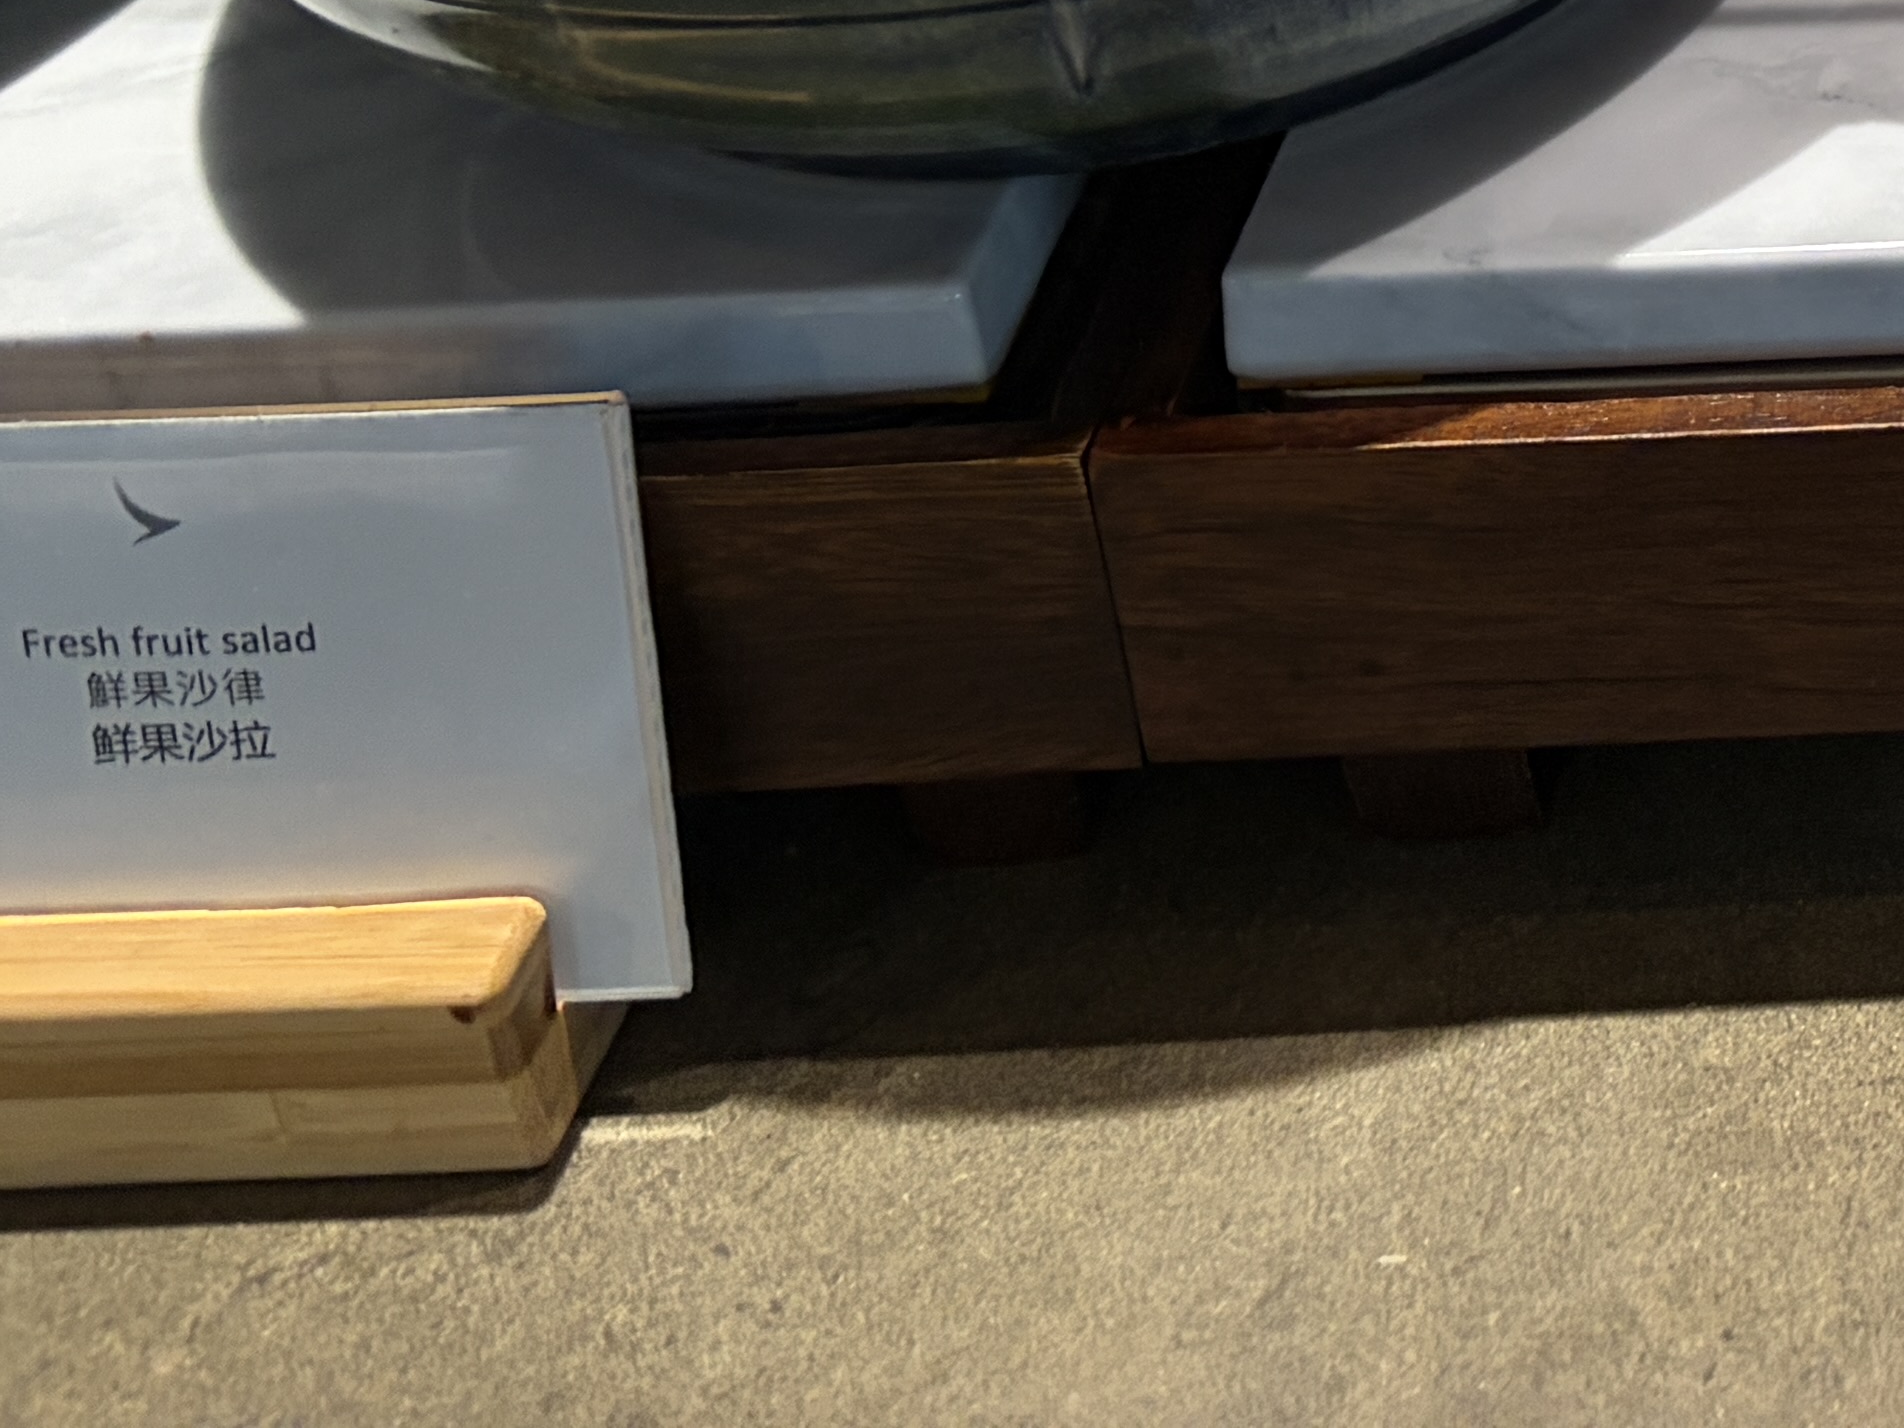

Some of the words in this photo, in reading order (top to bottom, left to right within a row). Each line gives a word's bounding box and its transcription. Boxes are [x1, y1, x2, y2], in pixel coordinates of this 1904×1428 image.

[22, 626, 120, 658] Fresh
[131, 625, 210, 657] fruit
[222, 622, 317, 655] salad
[87, 668, 266, 710] 鮮果沙律
[92, 719, 277, 765] 鲜果沙拉
